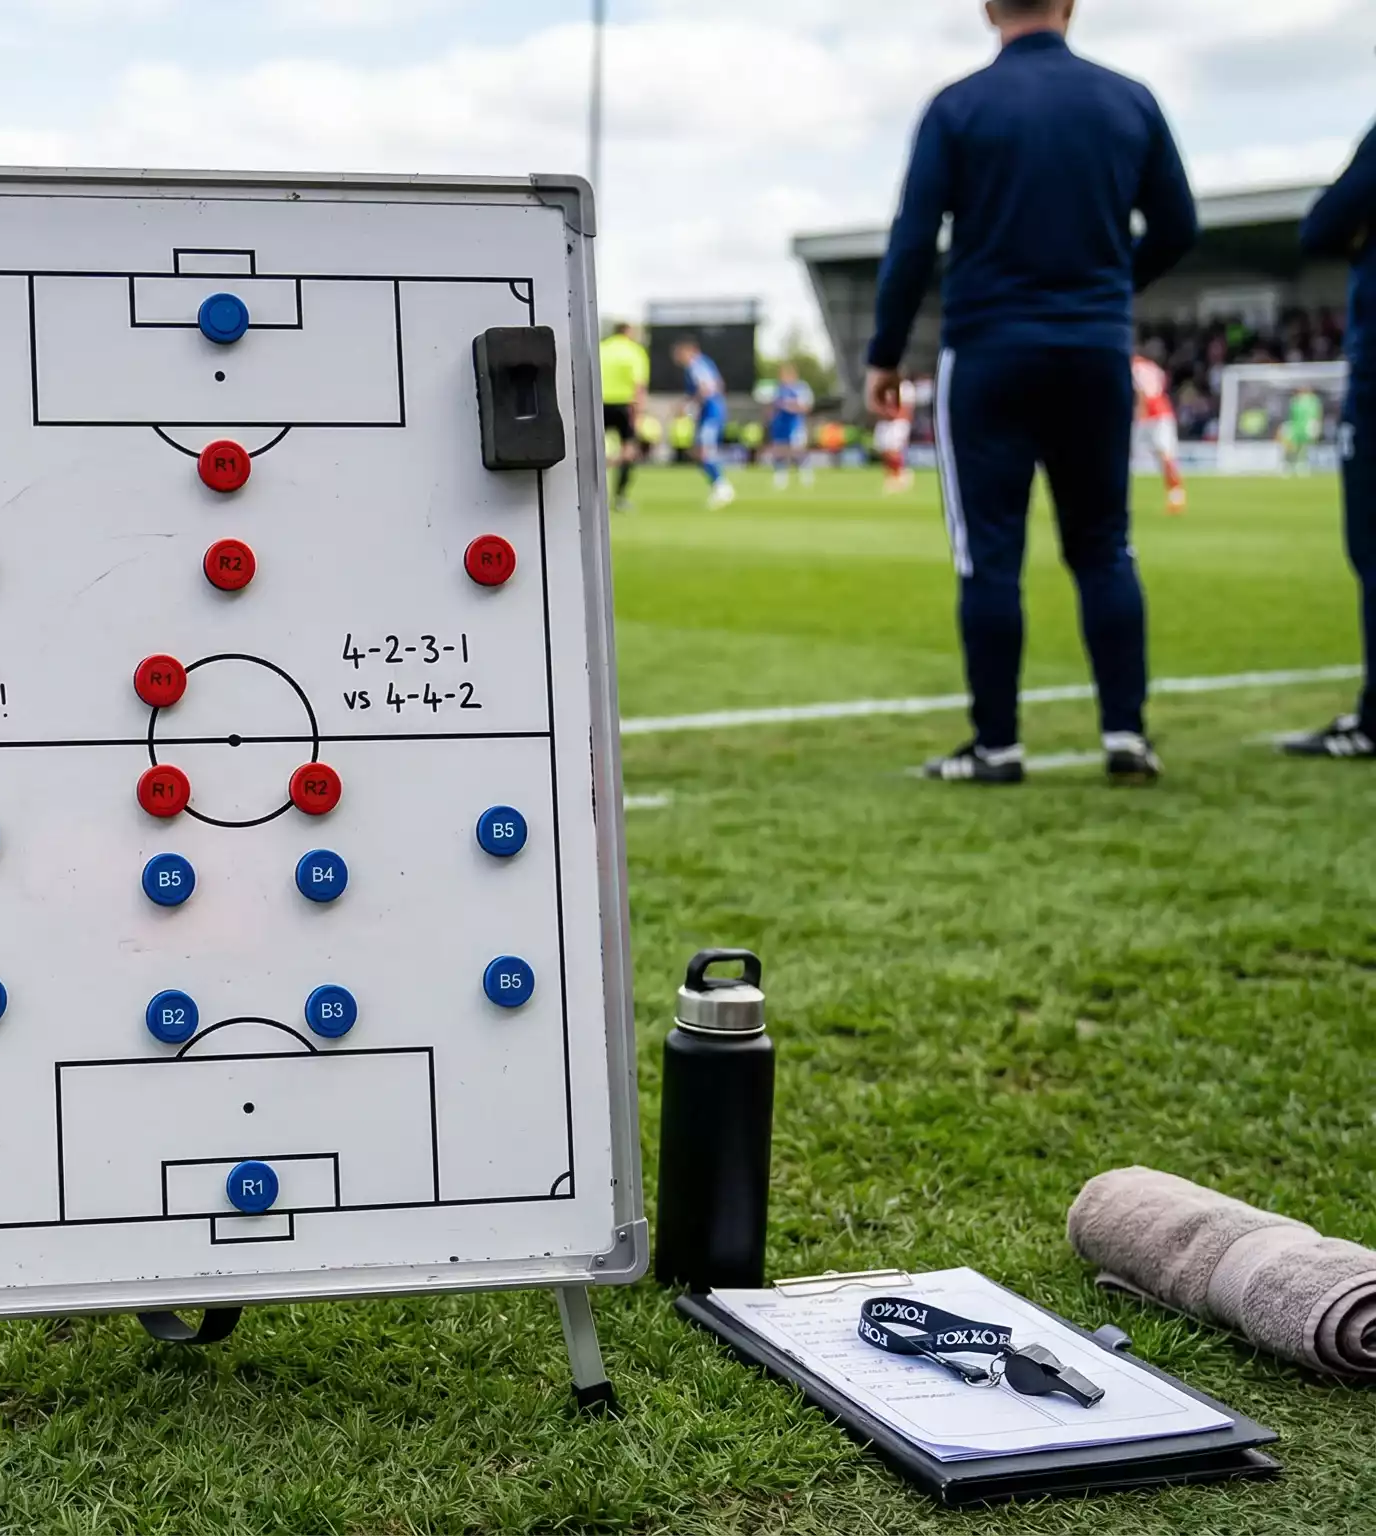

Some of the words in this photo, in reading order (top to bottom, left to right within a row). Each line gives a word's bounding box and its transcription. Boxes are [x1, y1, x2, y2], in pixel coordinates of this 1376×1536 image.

[215, 457, 237, 472] R1
[219, 556, 242, 571] R2
[481, 551, 503, 567] R1
[343, 633, 468, 669] 4-2-3-1
[150, 672, 172, 686] R1
[343, 691, 371, 710] vs
[386, 682, 482, 713] 4-4-2
[152, 782, 174, 798] R1
[304, 780, 328, 796] R2
[492, 822, 514, 838] B5
[159, 871, 181, 887] B5
[312, 867, 334, 882] B4
[500, 974, 522, 989] B5
[162, 1009, 185, 1024] B2
[321, 1002, 344, 1019] B3
[242, 1179, 263, 1196] R1
